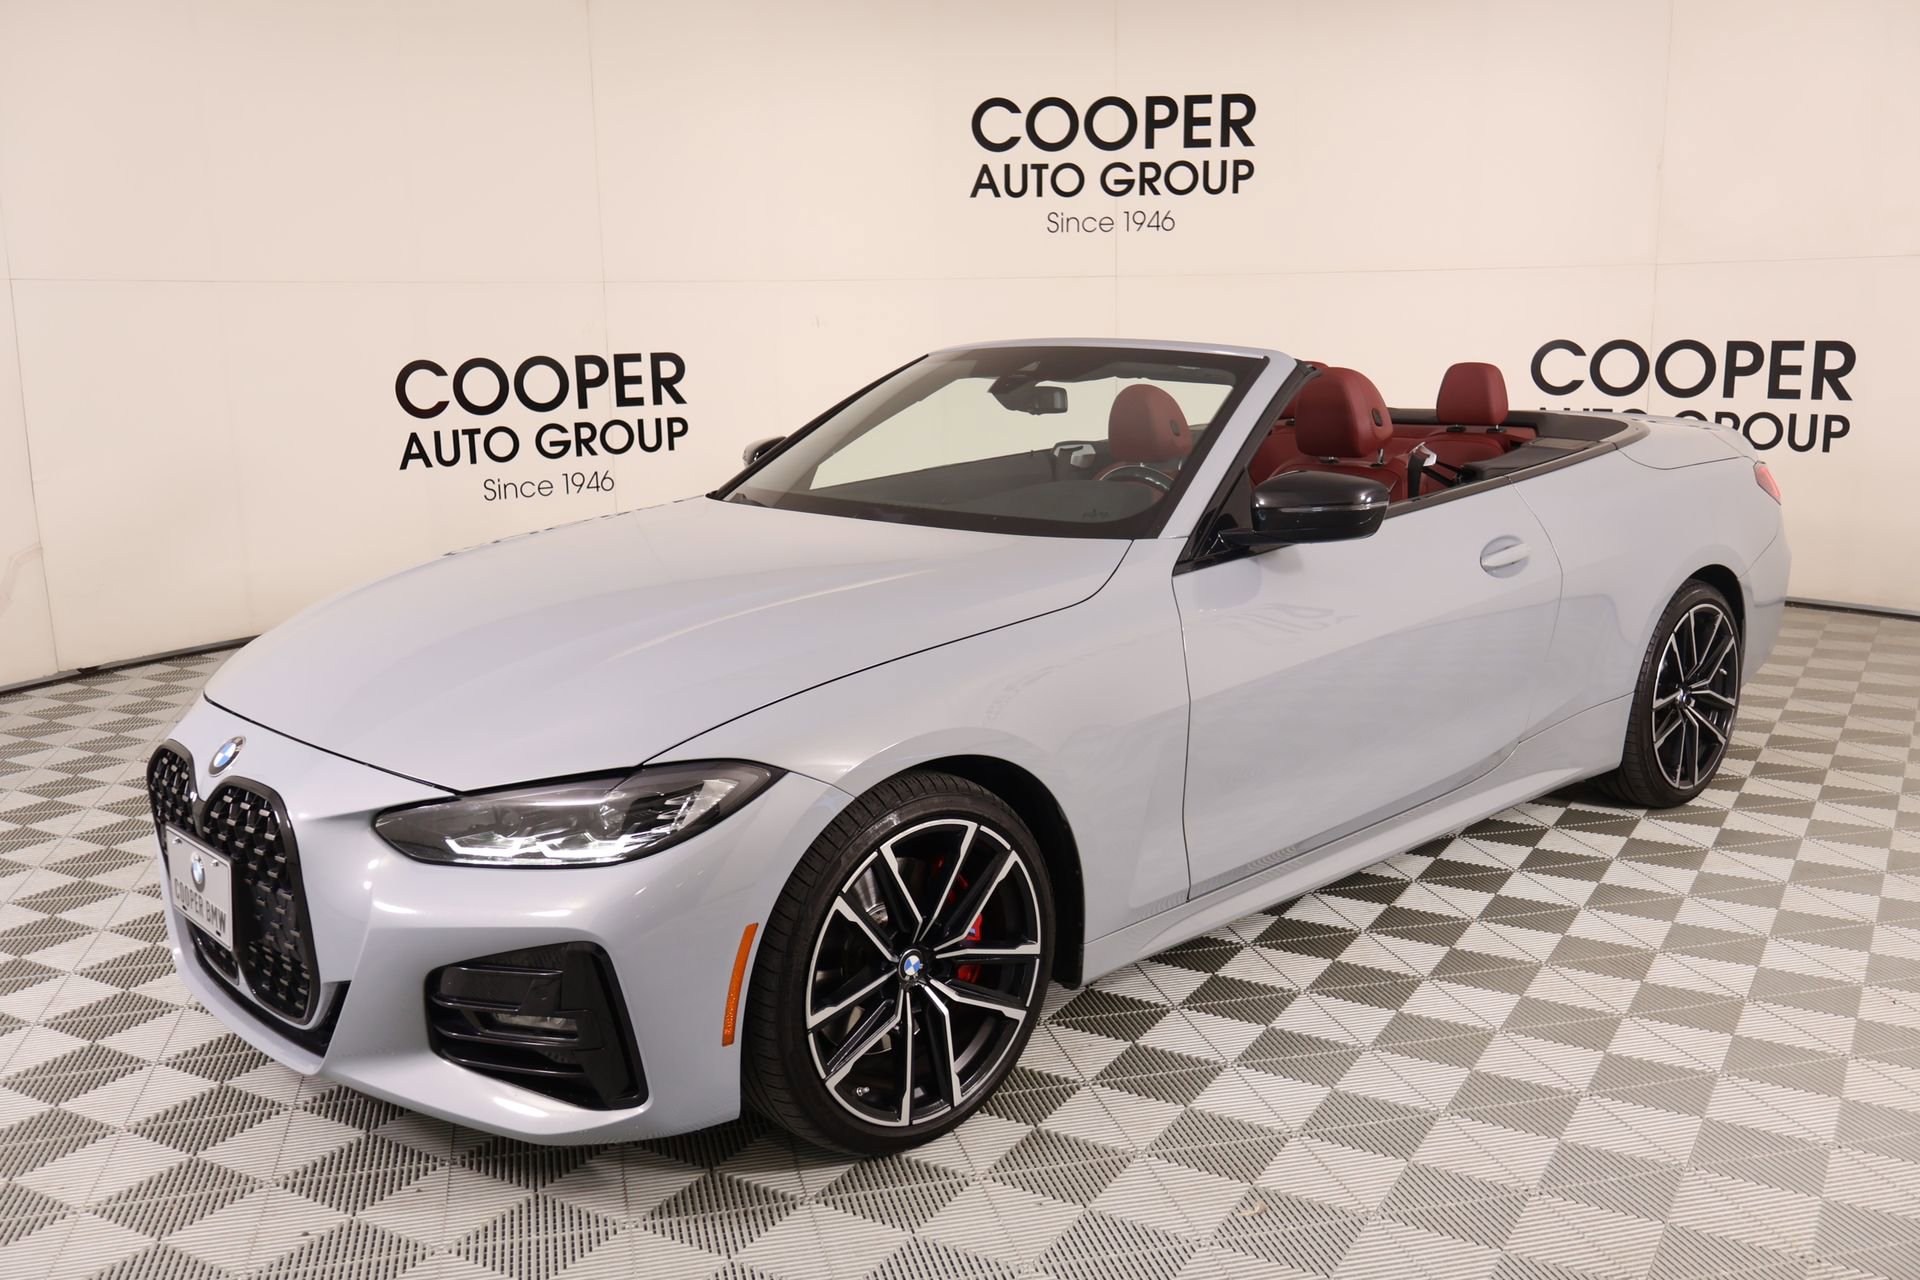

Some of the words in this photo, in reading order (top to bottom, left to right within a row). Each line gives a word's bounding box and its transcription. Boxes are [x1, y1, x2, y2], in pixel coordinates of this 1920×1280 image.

[971, 93, 1257, 153] COOPER
[969, 161, 1085, 198] AUTO
[1099, 159, 1255, 198] GROUP
[1047, 211, 1115, 233] Since
[1123, 210, 1176, 232] 1946
[395, 352, 688, 419] COOPER
[1530, 339, 1857, 401] COOPER
[399, 425, 520, 471] AUTO
[534, 416, 689, 460] GROUP
[1674, 409, 1851, 453] OUP
[483, 477, 554, 502] Since
[562, 470, 615, 495] 1946
[174, 877, 205, 917] COOPER
[206, 900, 227, 934] BMW
